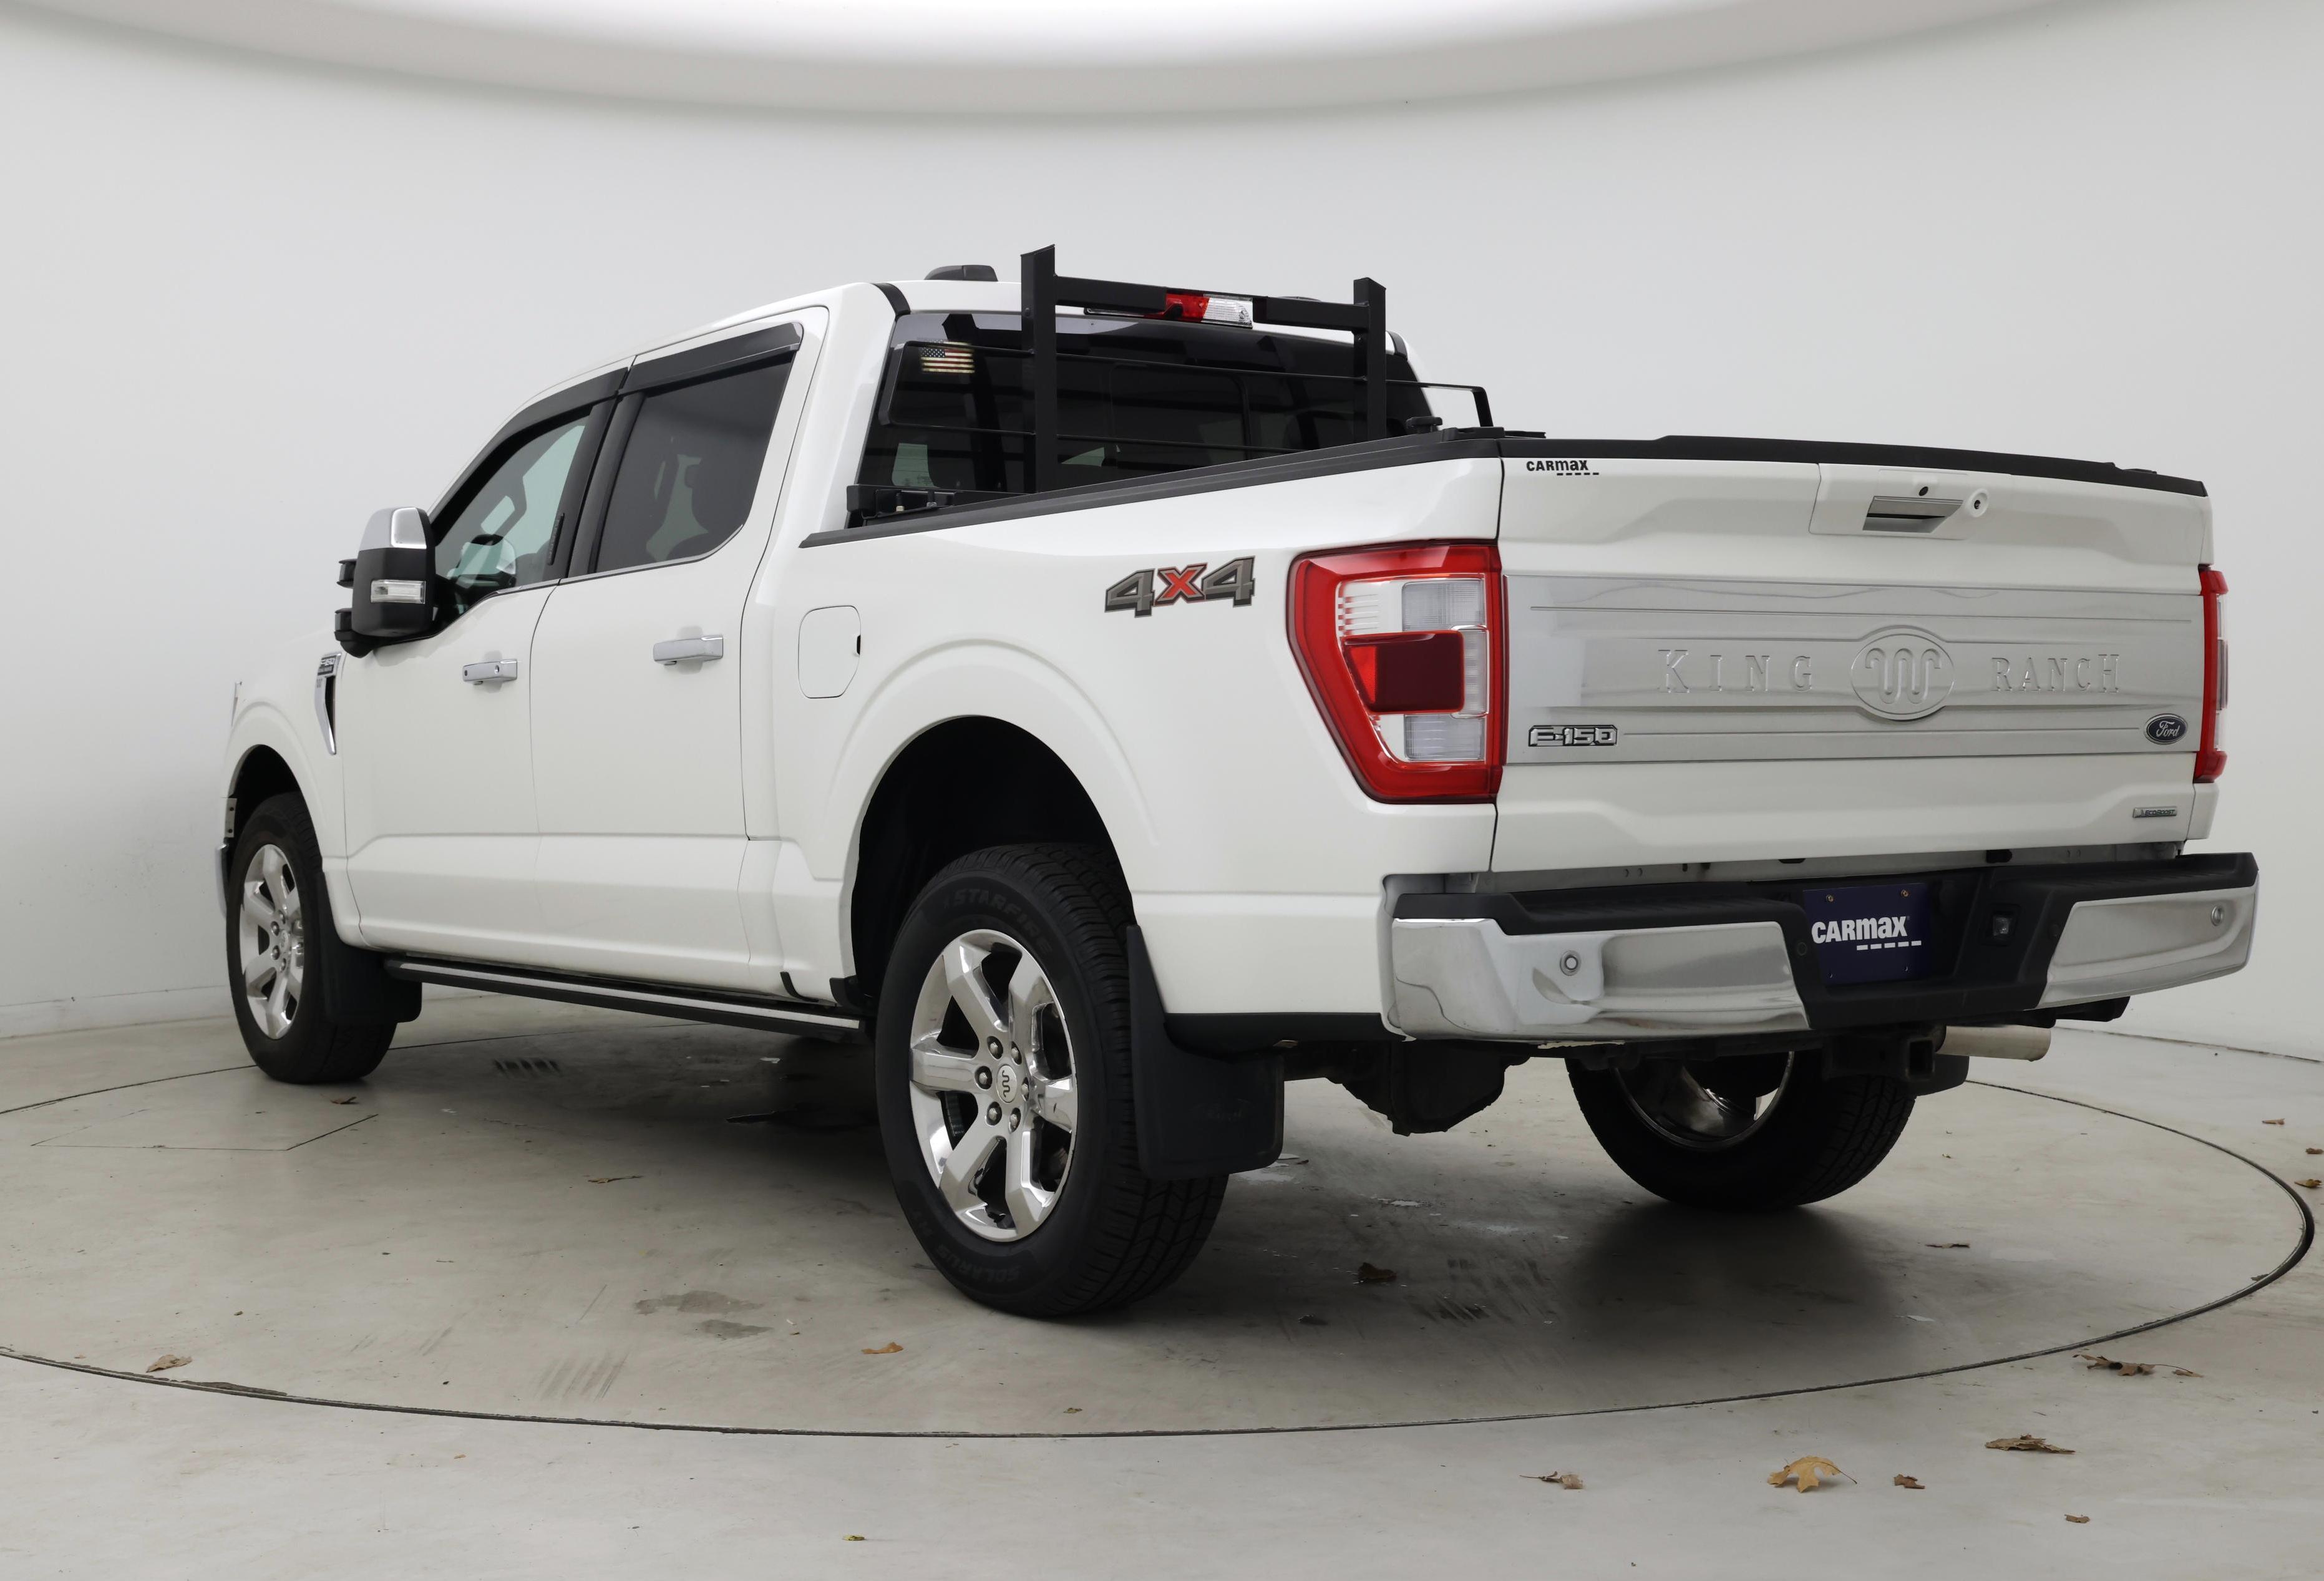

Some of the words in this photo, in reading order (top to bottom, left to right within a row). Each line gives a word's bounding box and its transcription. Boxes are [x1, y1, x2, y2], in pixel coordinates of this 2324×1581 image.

[1657, 649, 1813, 693] KING
[1990, 654, 2120, 693] RANCH
[1528, 724, 1618, 747] F-150
[2156, 721, 2181, 737] Ford
[953, 888, 1053, 955] STARFIRE
